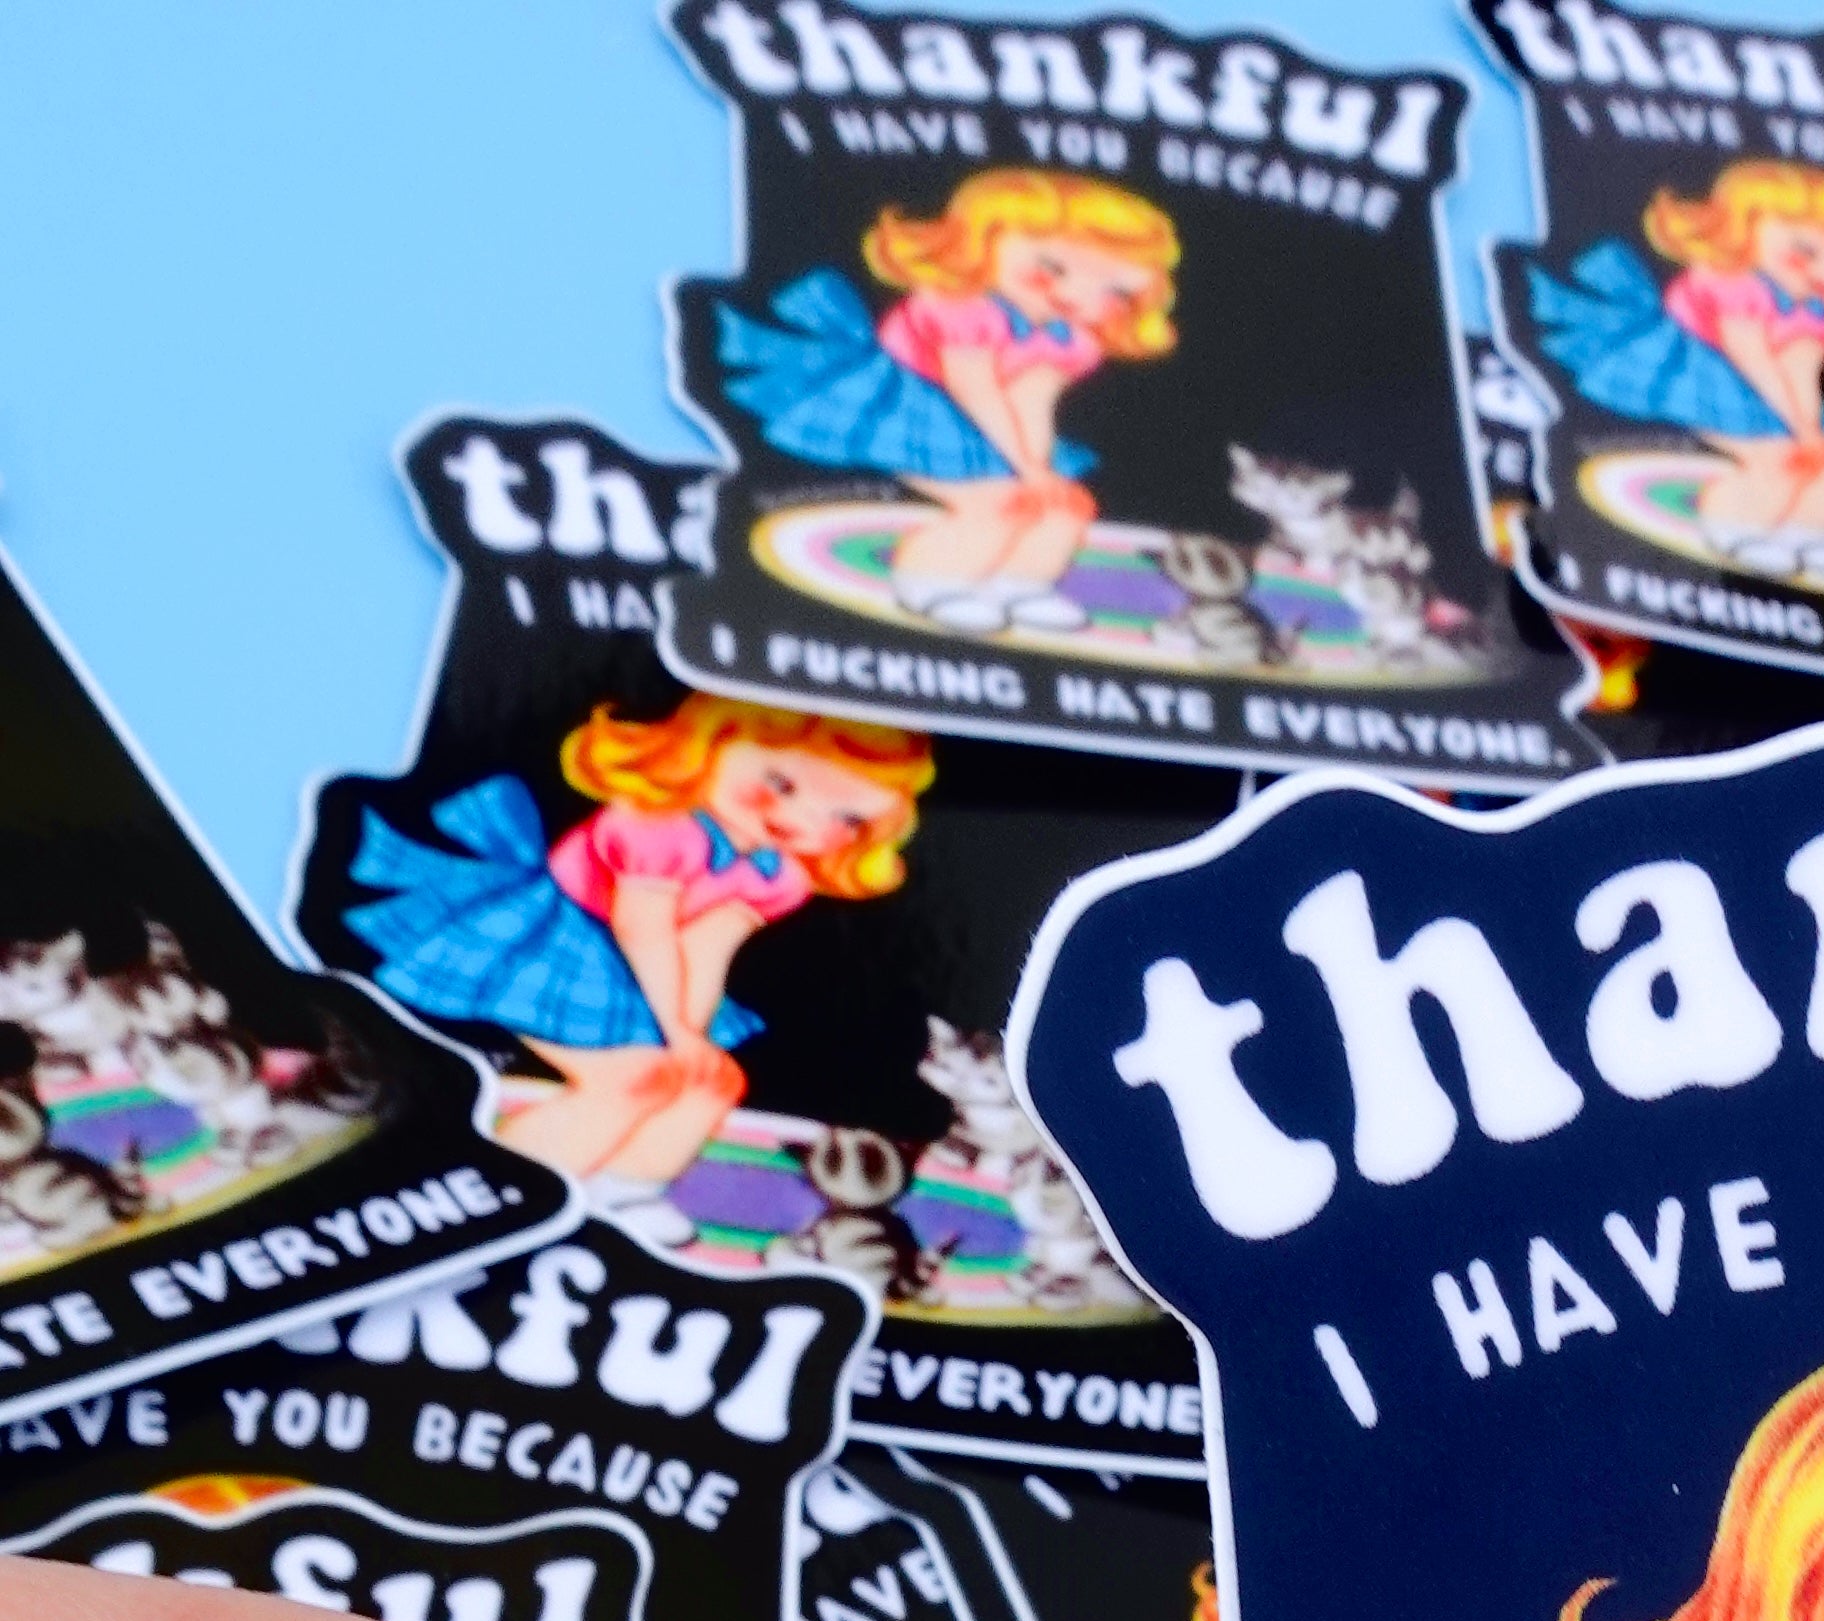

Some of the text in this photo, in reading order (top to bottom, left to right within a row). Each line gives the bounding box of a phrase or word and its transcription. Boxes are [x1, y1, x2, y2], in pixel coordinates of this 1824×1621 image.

[702, 0, 1442, 177] thankful
[1563, 96, 1594, 137] I
[1606, 99, 1742, 149] HAVE
[780, 106, 1399, 232] I HAVE YOU BECAUSE
[504, 573, 536, 629] I
[711, 622, 1572, 768] I FUCKING HATE EVERYONE.
[131, 1166, 524, 1320] EVERYONE.
[1313, 1323, 1379, 1429] I
[1431, 1176, 1786, 1380] HAVE
[222, 1386, 370, 1452] YOU
[413, 1402, 740, 1533] BECAUSE
